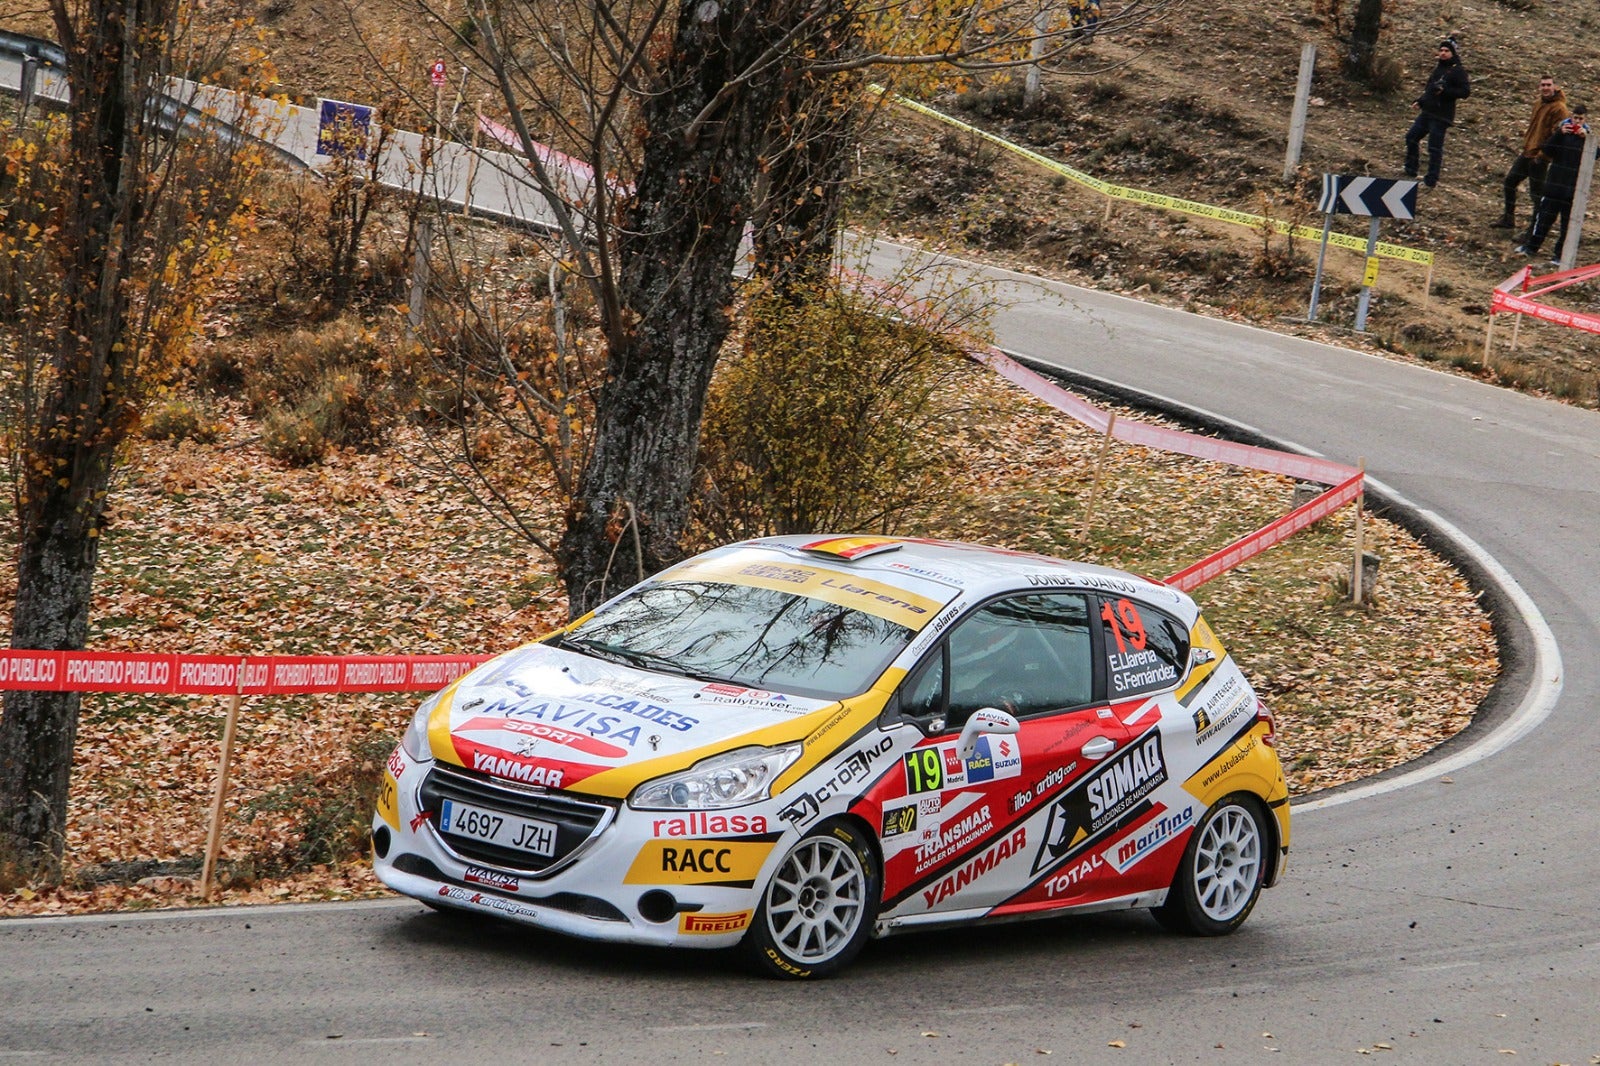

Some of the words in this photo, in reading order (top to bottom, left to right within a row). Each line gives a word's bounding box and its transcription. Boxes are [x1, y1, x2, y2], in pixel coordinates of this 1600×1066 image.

[1126, 190, 1143, 201] ZONA
[1142, 193, 1167, 206] PUBLICO
[1171, 199, 1188, 210] ZONA
[1188, 203, 1214, 216] PUBLICO
[1218, 210, 1234, 220] ZONA
[1330, 234, 1357, 248] PUBLICO
[1379, 244, 1406, 258] PUBLICO
[1411, 251, 1429, 262] ZONA
[820, 577, 928, 614] Llarena
[1024, 574, 1075, 586] DONDE
[1079, 578, 1136, 594] JUANJO
[1101, 597, 1147, 654] 19
[8, 658, 56, 682] PUBLICO
[66, 659, 124, 684] PROHIBIDO
[124, 660, 170, 685] PUBLICO
[412, 662, 446, 684] PROHIBIDO
[1108, 650, 1158, 673] E.Llarena
[179, 661, 235, 686] PROHIBIDO
[273, 663, 311, 686] PROHIBIDO
[310, 663, 340, 686] PUBLICO
[343, 663, 380, 685] PROHIBIDO
[379, 662, 408, 685] PUBLICO
[1113, 664, 1177, 692] S.Fernández
[1206, 676, 1237, 710] AURTENECHE
[482, 697, 643, 747] MAVISA
[502, 721, 585, 744] SPORT
[472, 751, 565, 789] YANMAR
[908, 749, 941, 793] 19
[968, 757, 992, 770] RACE
[994, 757, 1021, 769] SUZUKI
[947, 775, 965, 785] Madrid
[1086, 735, 1163, 821] SOMAQ
[920, 797, 941, 810] AUTO
[1091, 801, 1126, 832] SOLUCIONES
[1125, 795, 1134, 808] DE
[1132, 772, 1165, 801] MAQUINARIA
[455, 808, 504, 841] 4697
[511, 823, 553, 854] JZH
[652, 812, 769, 838] rallasa
[914, 804, 992, 863] TRANSMAR
[914, 850, 947, 875] ALQUILER
[946, 844, 957, 856] DE
[956, 820, 995, 851] MAQUINARIA
[661, 847, 731, 873] RACC
[922, 826, 1028, 910] YANMAR
[465, 865, 520, 887] MAVISA
[478, 877, 506, 889] SPORT
[1043, 853, 1105, 899] TOTAL
[684, 912, 748, 931] PIRELLI
